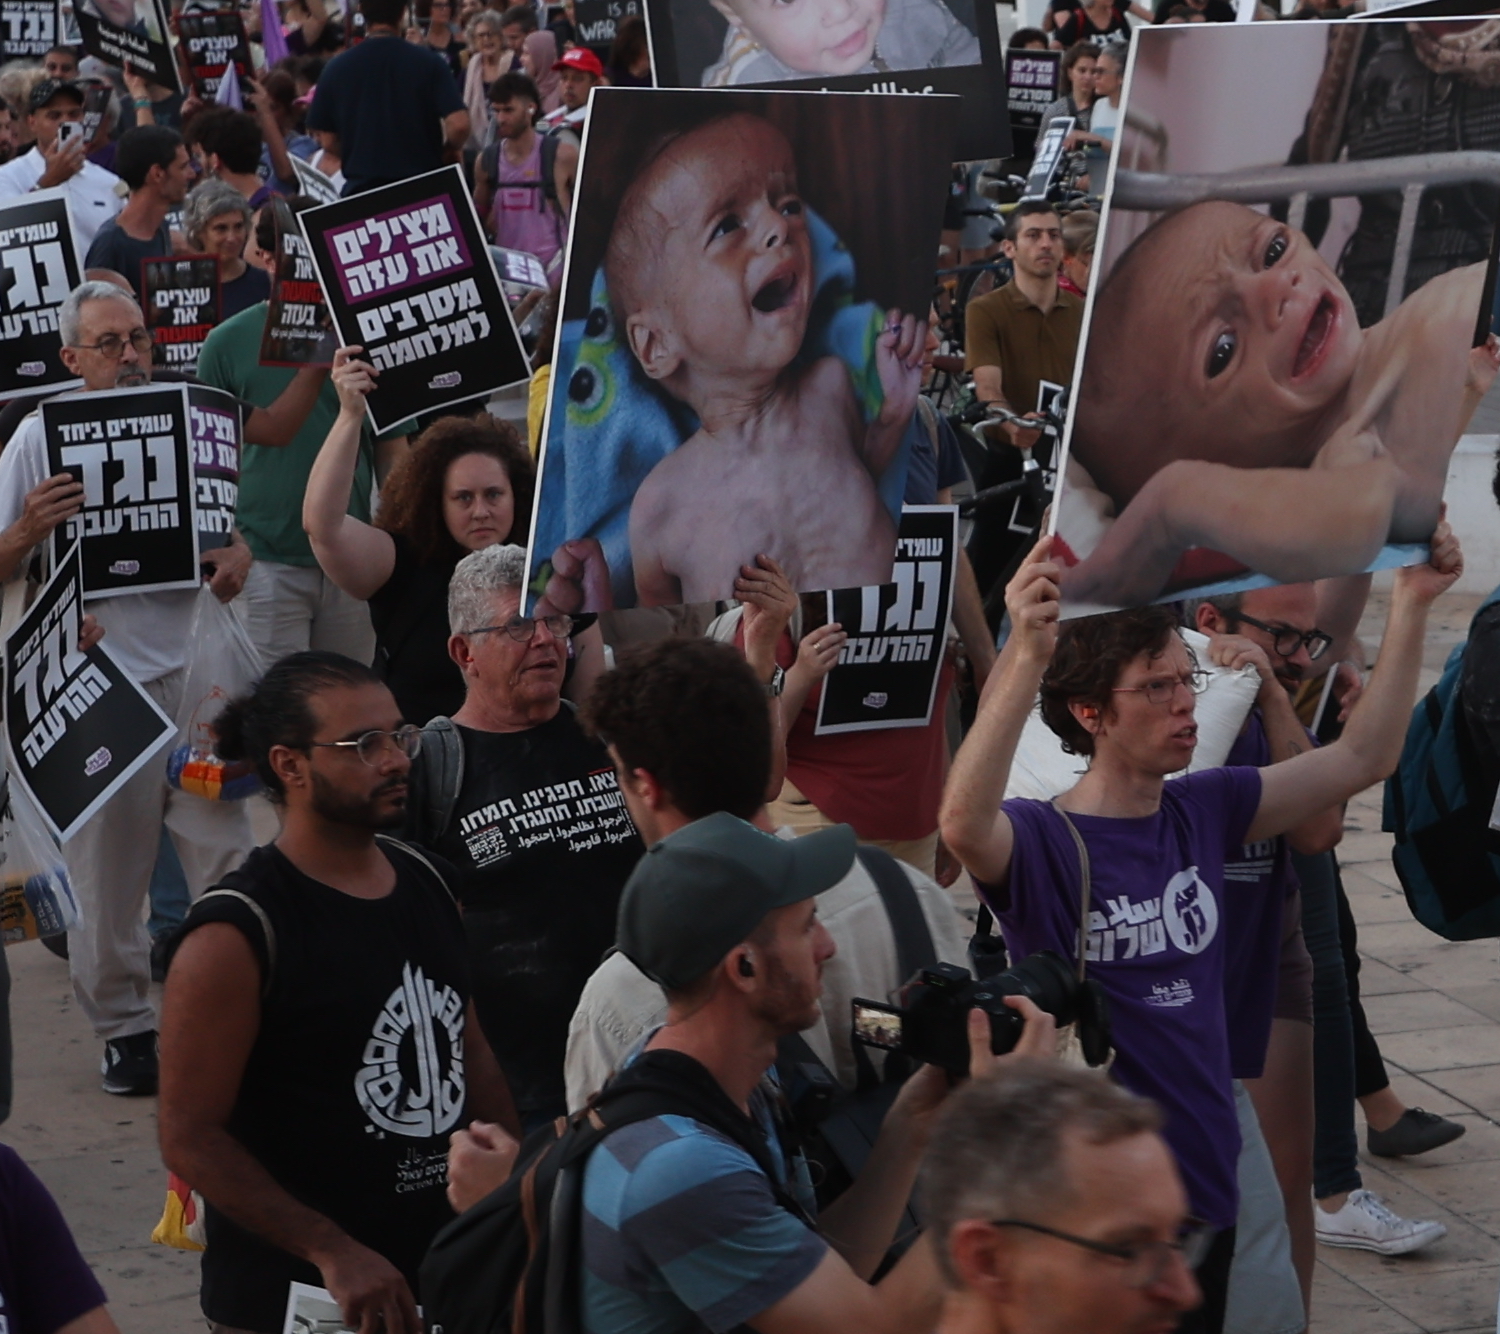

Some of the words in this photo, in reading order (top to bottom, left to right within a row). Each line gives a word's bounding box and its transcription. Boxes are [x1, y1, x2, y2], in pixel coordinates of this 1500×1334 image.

[2, 11, 56, 41] נגד
[608, 1, 622, 16] IS
[627, 0, 639, 15] A
[579, 20, 618, 42] WAR
[332, 202, 453, 265] מצילים
[411, 236, 465, 276] את
[156, 286, 211, 308] עוצרים
[344, 258, 410, 298] עזה
[173, 305, 199, 325] את
[280, 302, 317, 326] בעזה
[355, 277, 482, 343] מסרבים
[368, 311, 492, 372] למלחמה
[57, 421, 105, 444] ביחד
[106, 412, 174, 438] עומדים
[191, 406, 237, 446] מציל
[60, 435, 179, 508] נגד
[66, 502, 180, 540] ההרעבה
[895, 537, 944, 557] עומדי
[41, 577, 77, 633] עומדים
[12, 596, 89, 726] נגד
[13, 624, 40, 667] ביחד
[838, 633, 934, 665] ההרעבה
[20, 662, 114, 769] ההרעבה
[522, 778, 586, 811] תפגינו.
[588, 771, 619, 794] צאו.
[459, 798, 518, 836] תמחו.
[508, 802, 573, 836] תתנגדו.
[1074, 918, 1168, 962] שלום
